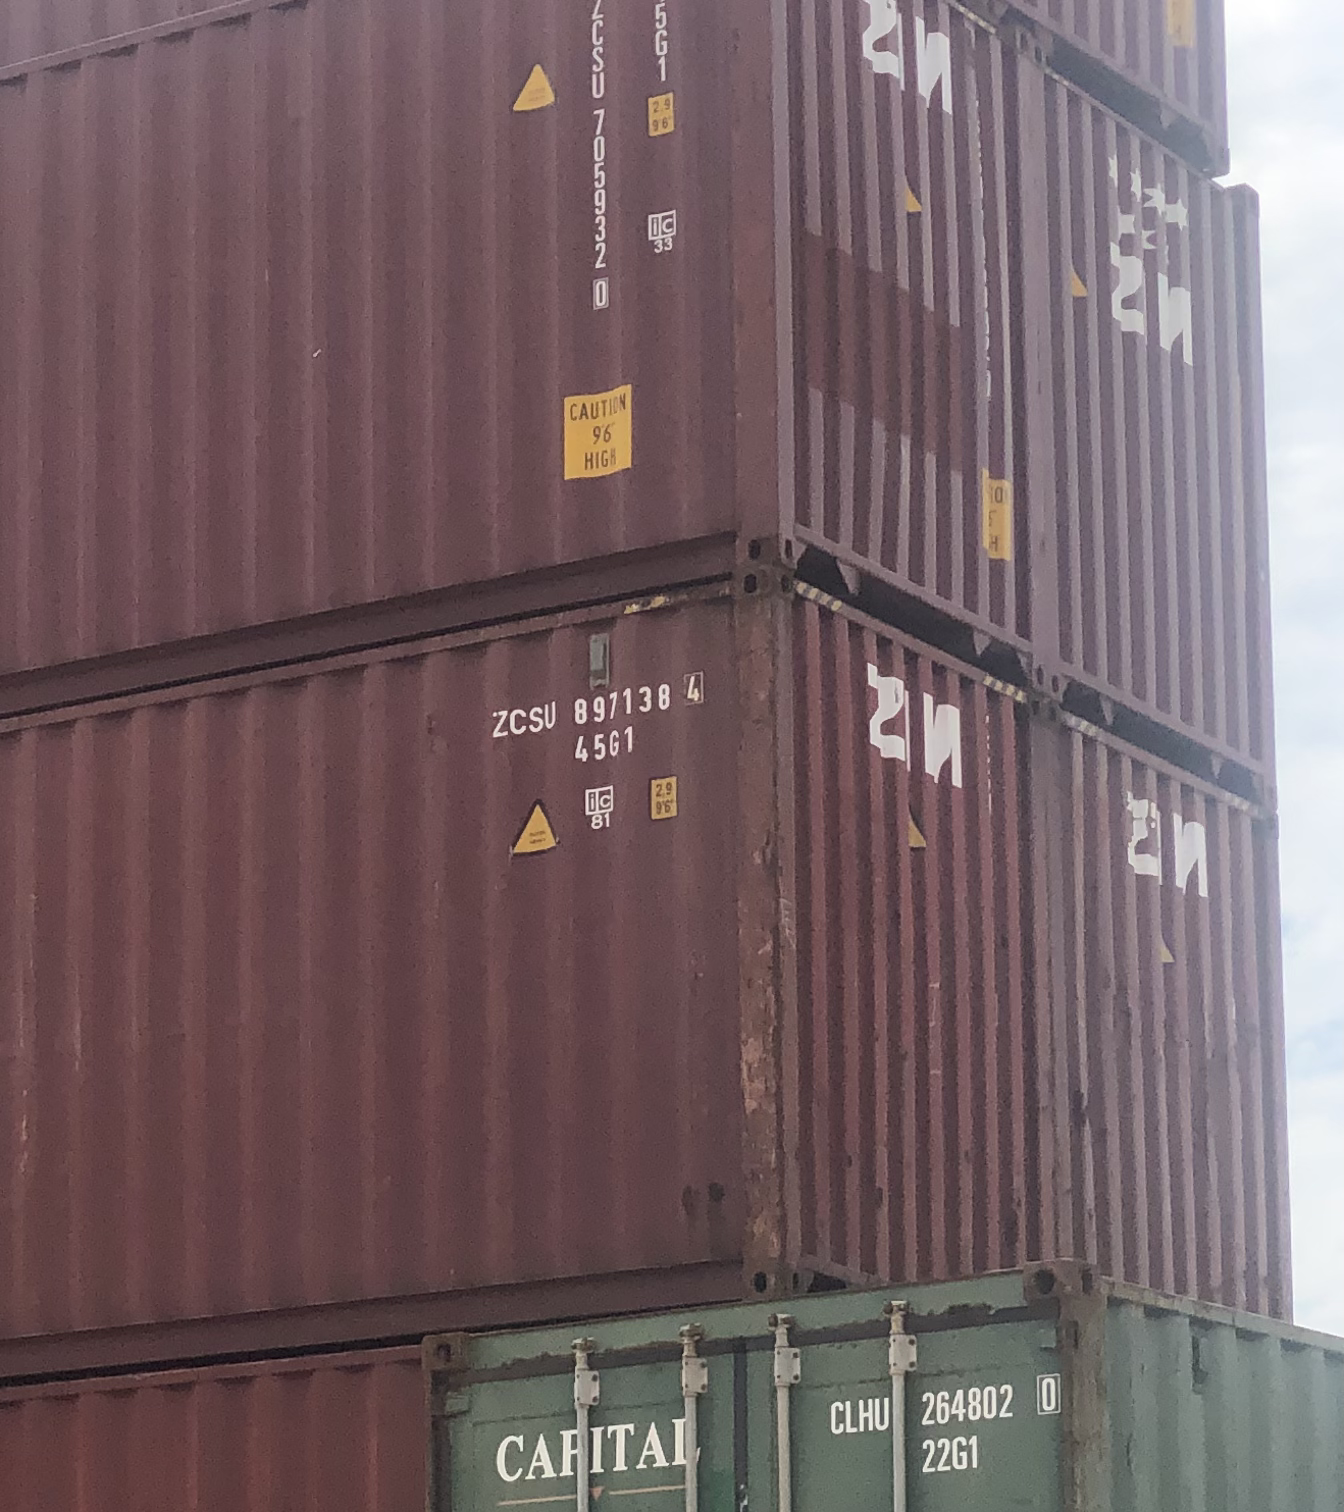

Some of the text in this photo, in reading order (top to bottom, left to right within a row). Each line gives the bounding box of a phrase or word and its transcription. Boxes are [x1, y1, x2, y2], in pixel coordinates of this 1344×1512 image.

[593, 108, 606, 268] 705932
[654, 238, 672, 253] 33
[594, 279, 608, 308] 0
[570, 393, 626, 421] CAUTION
[584, 448, 616, 470] HIGH
[493, 673, 701, 738] ZCSU 897138 4
[575, 726, 633, 762] 45G1
[591, 815, 610, 829] 81
[830, 1376, 1058, 1434] CLHU 264802 0
[923, 1436, 978, 1472] 22G1
